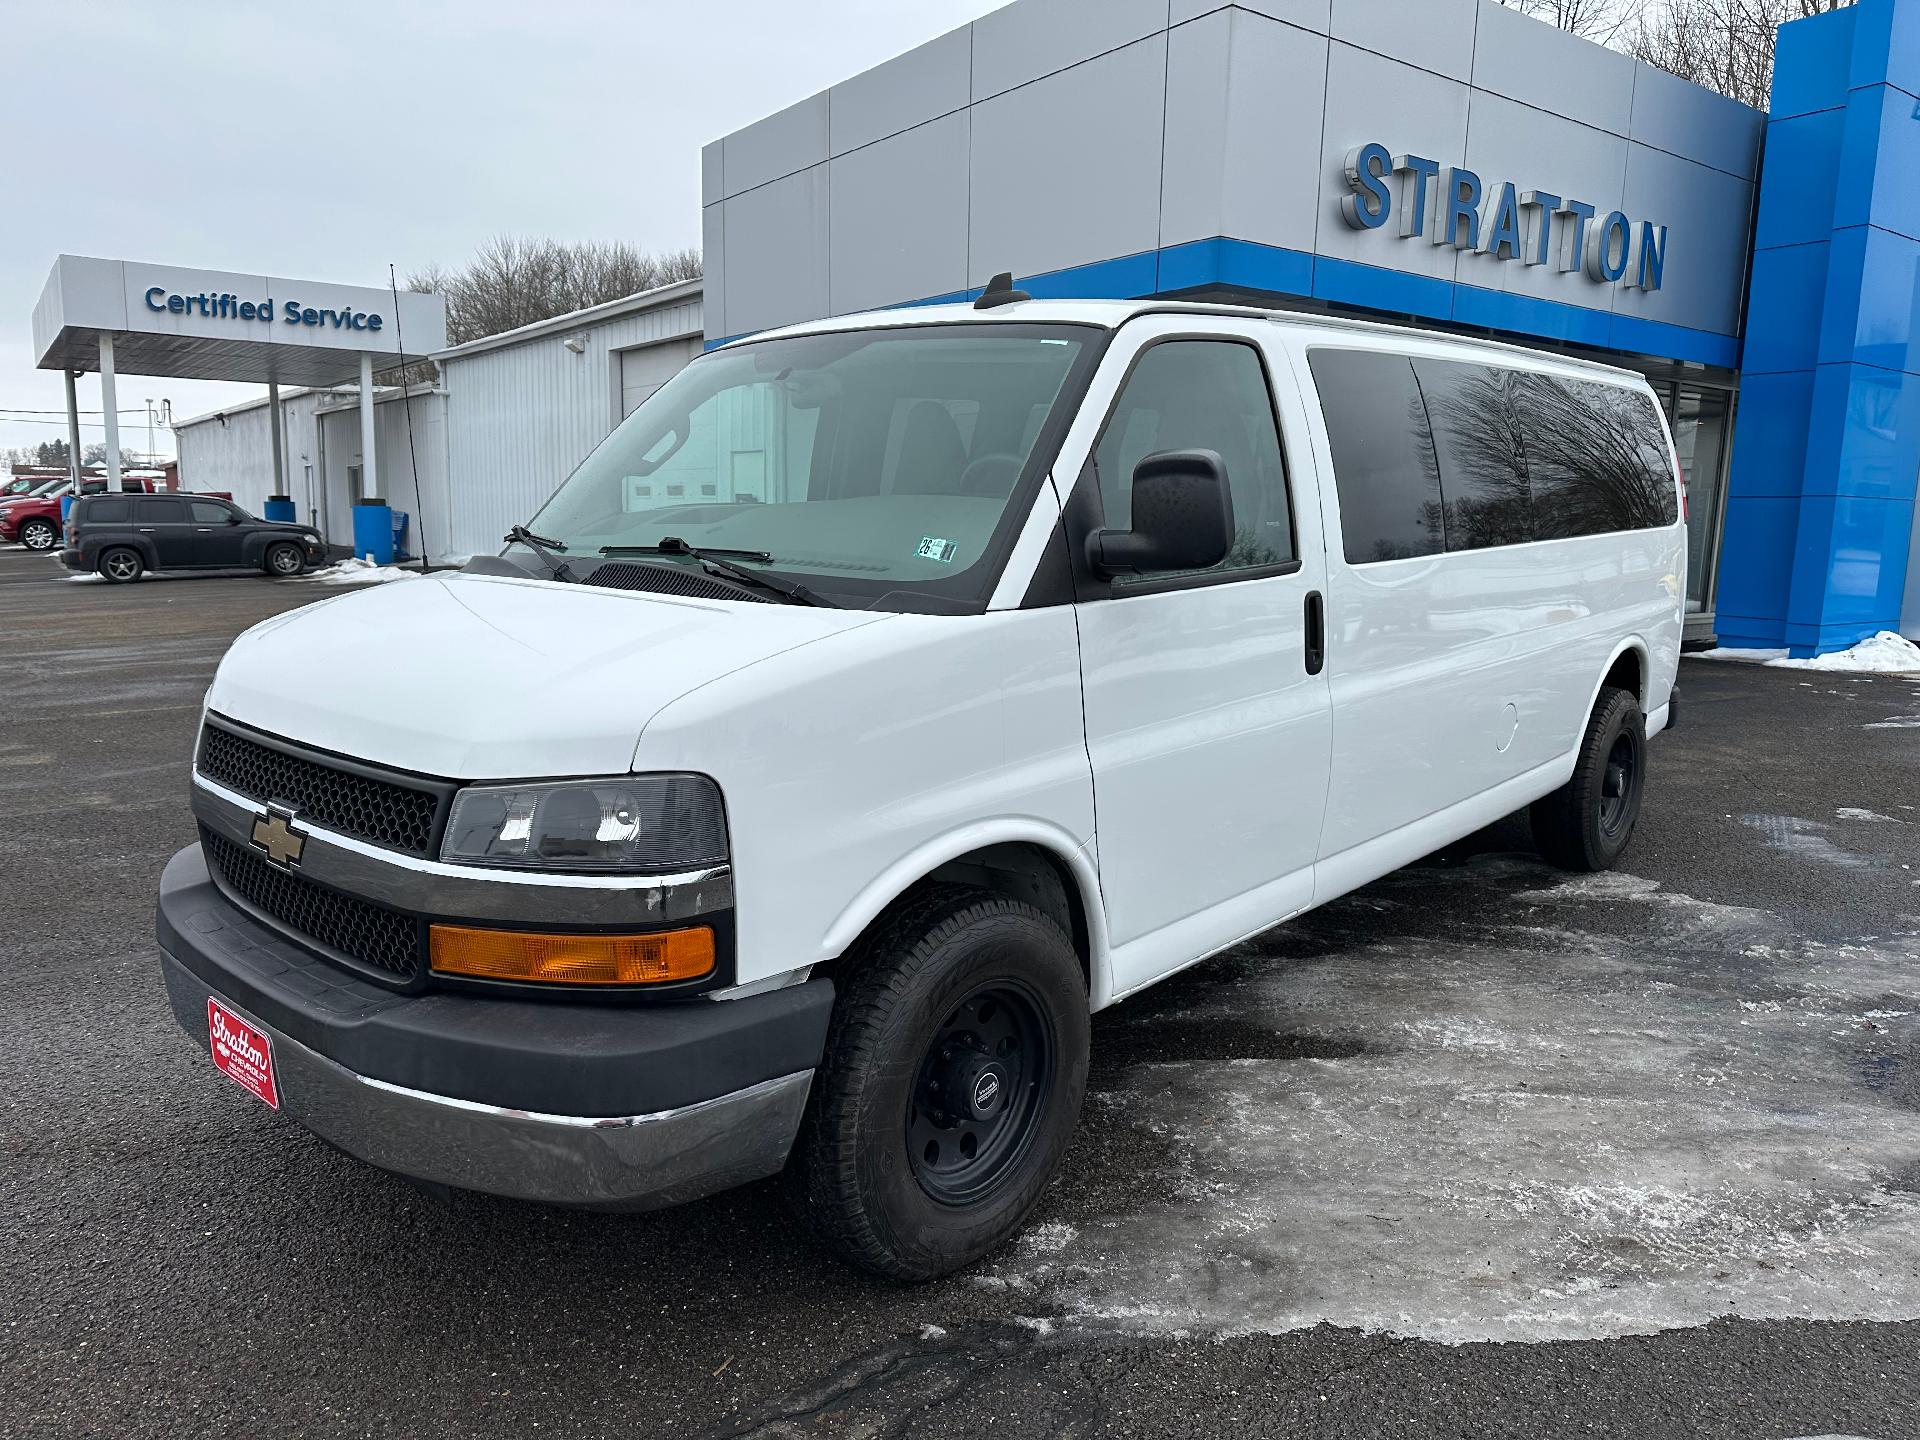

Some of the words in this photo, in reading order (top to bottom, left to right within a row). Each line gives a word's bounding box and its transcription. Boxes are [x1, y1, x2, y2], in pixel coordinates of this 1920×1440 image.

[1341, 142, 1668, 292] STRATTON
[144, 286, 274, 322] Certified
[284, 300, 383, 332] Service
[919, 538, 933, 555] 26
[212, 1011, 268, 1071] Stratton
[230, 1052, 268, 1084] CHEVROLET
